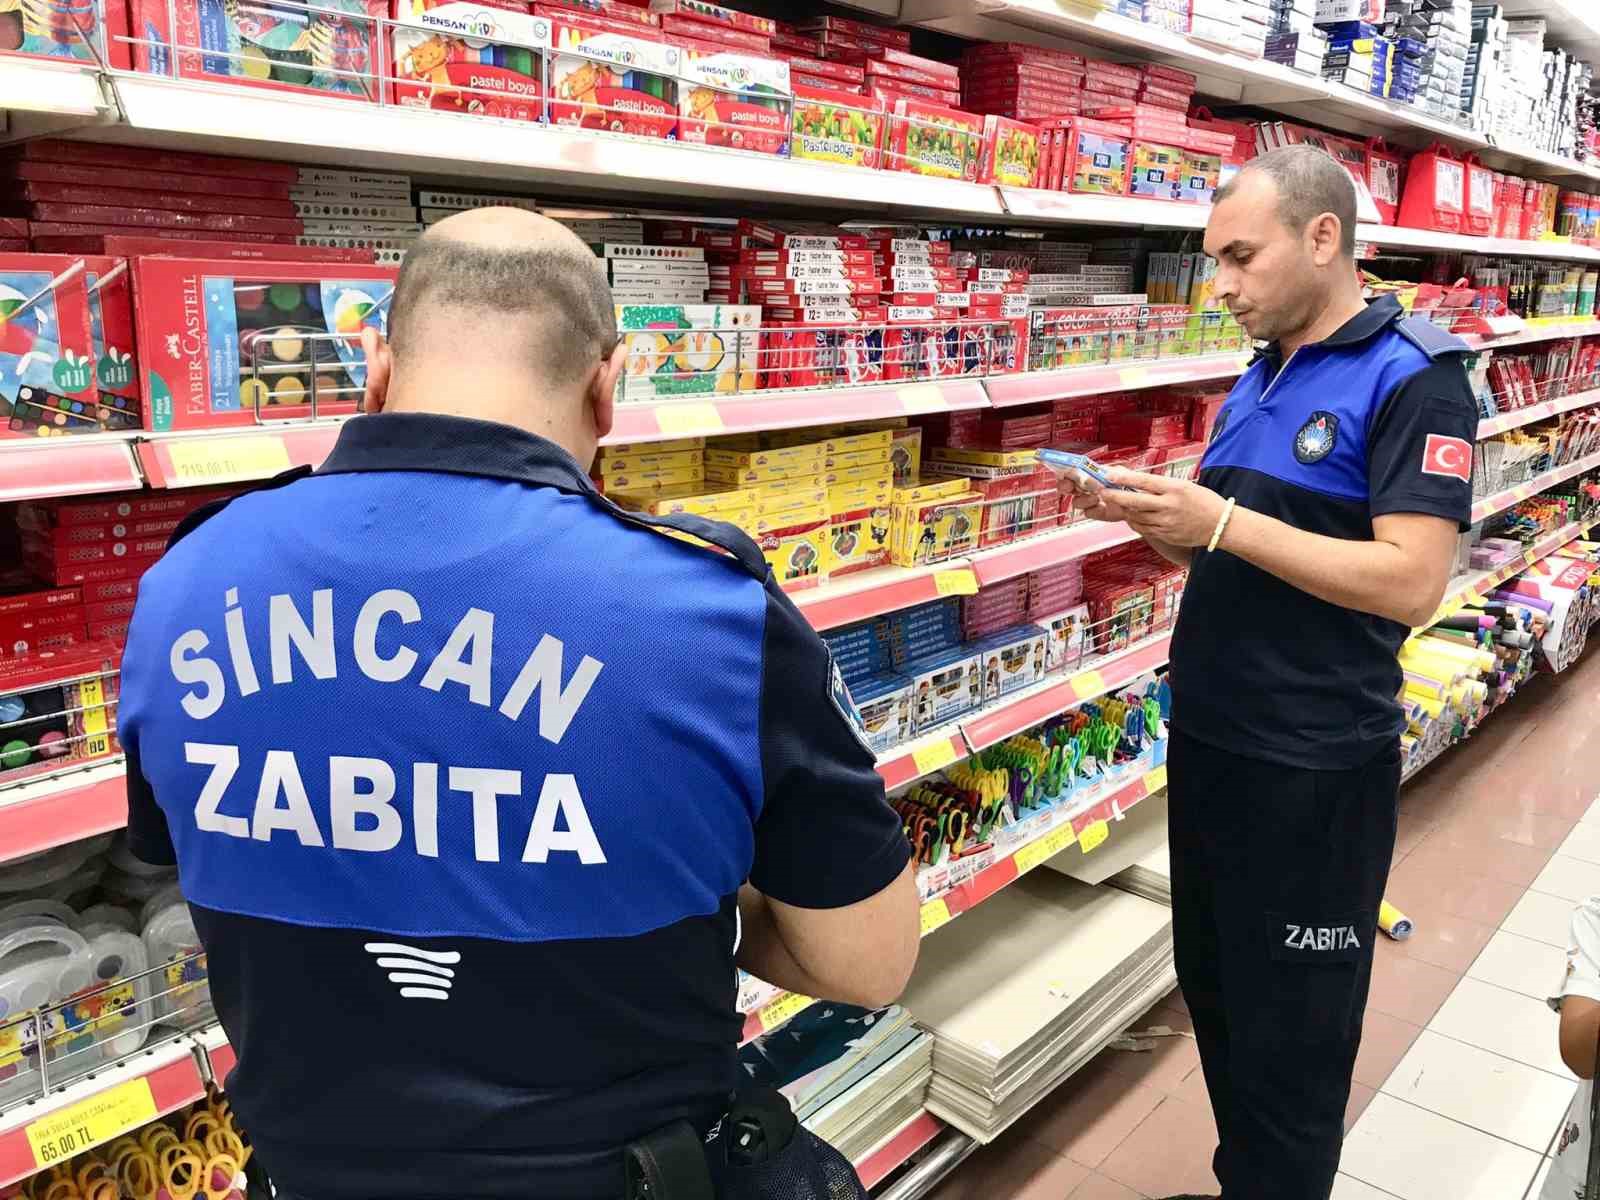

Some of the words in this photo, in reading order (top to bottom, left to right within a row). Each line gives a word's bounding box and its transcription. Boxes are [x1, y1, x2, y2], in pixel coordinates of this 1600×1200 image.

[422, 15, 466, 30] PENSAN
[470, 75, 505, 89] pastel
[508, 78, 535, 95] boya
[614, 99, 641, 112] pastel
[643, 101, 665, 115] boya
[731, 111, 757, 123] pastel
[759, 113, 780, 126] boya
[794, 251, 801, 263] 12
[791, 266, 799, 277] 12
[808, 309, 816, 321] 12
[1032, 311, 1045, 329] 12
[182, 274, 206, 415] FABER-CASTELL
[170, 586, 604, 744] SİNCAN
[184, 742, 607, 865] ZABITA
[1285, 924, 1360, 951] ZABITA
[40, 1133, 76, 1162] 65.00
[76, 1126, 95, 1145] TL
